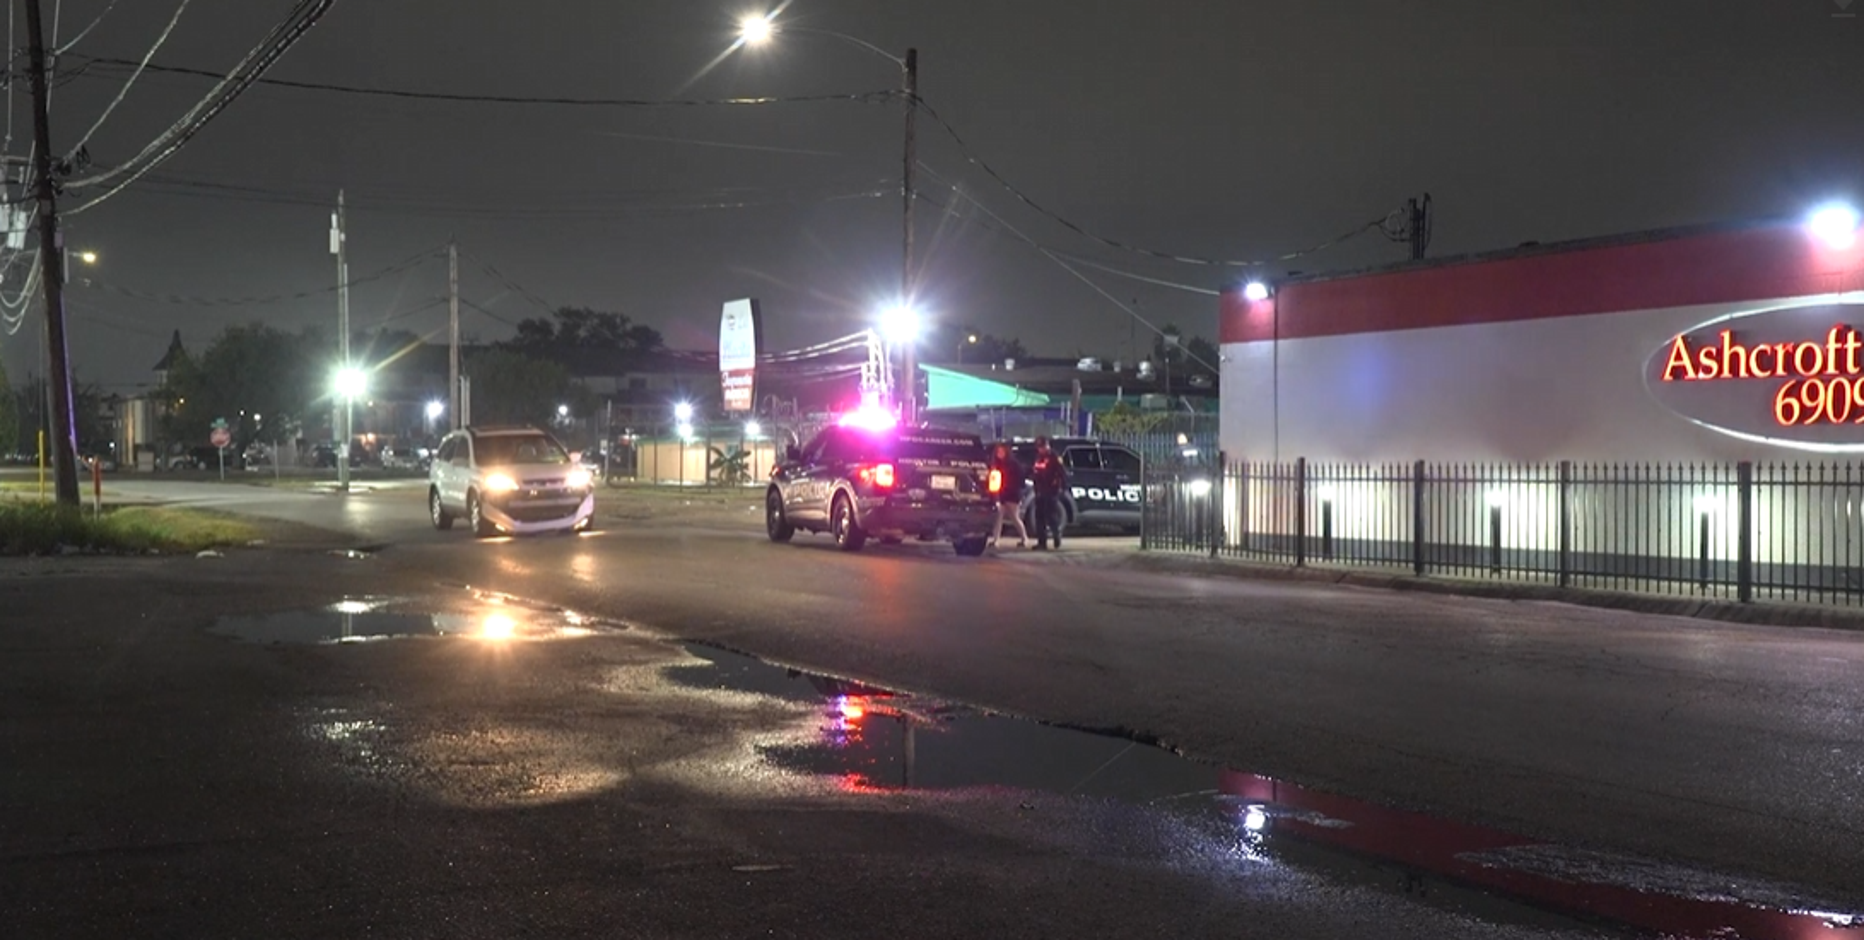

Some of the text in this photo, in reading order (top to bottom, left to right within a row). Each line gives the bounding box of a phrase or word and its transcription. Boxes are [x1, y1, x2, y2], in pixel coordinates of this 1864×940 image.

[1662, 323, 1862, 381] Ashcroft
[950, 460, 988, 469] POLICE
[1070, 486, 1141, 502] POLIC
